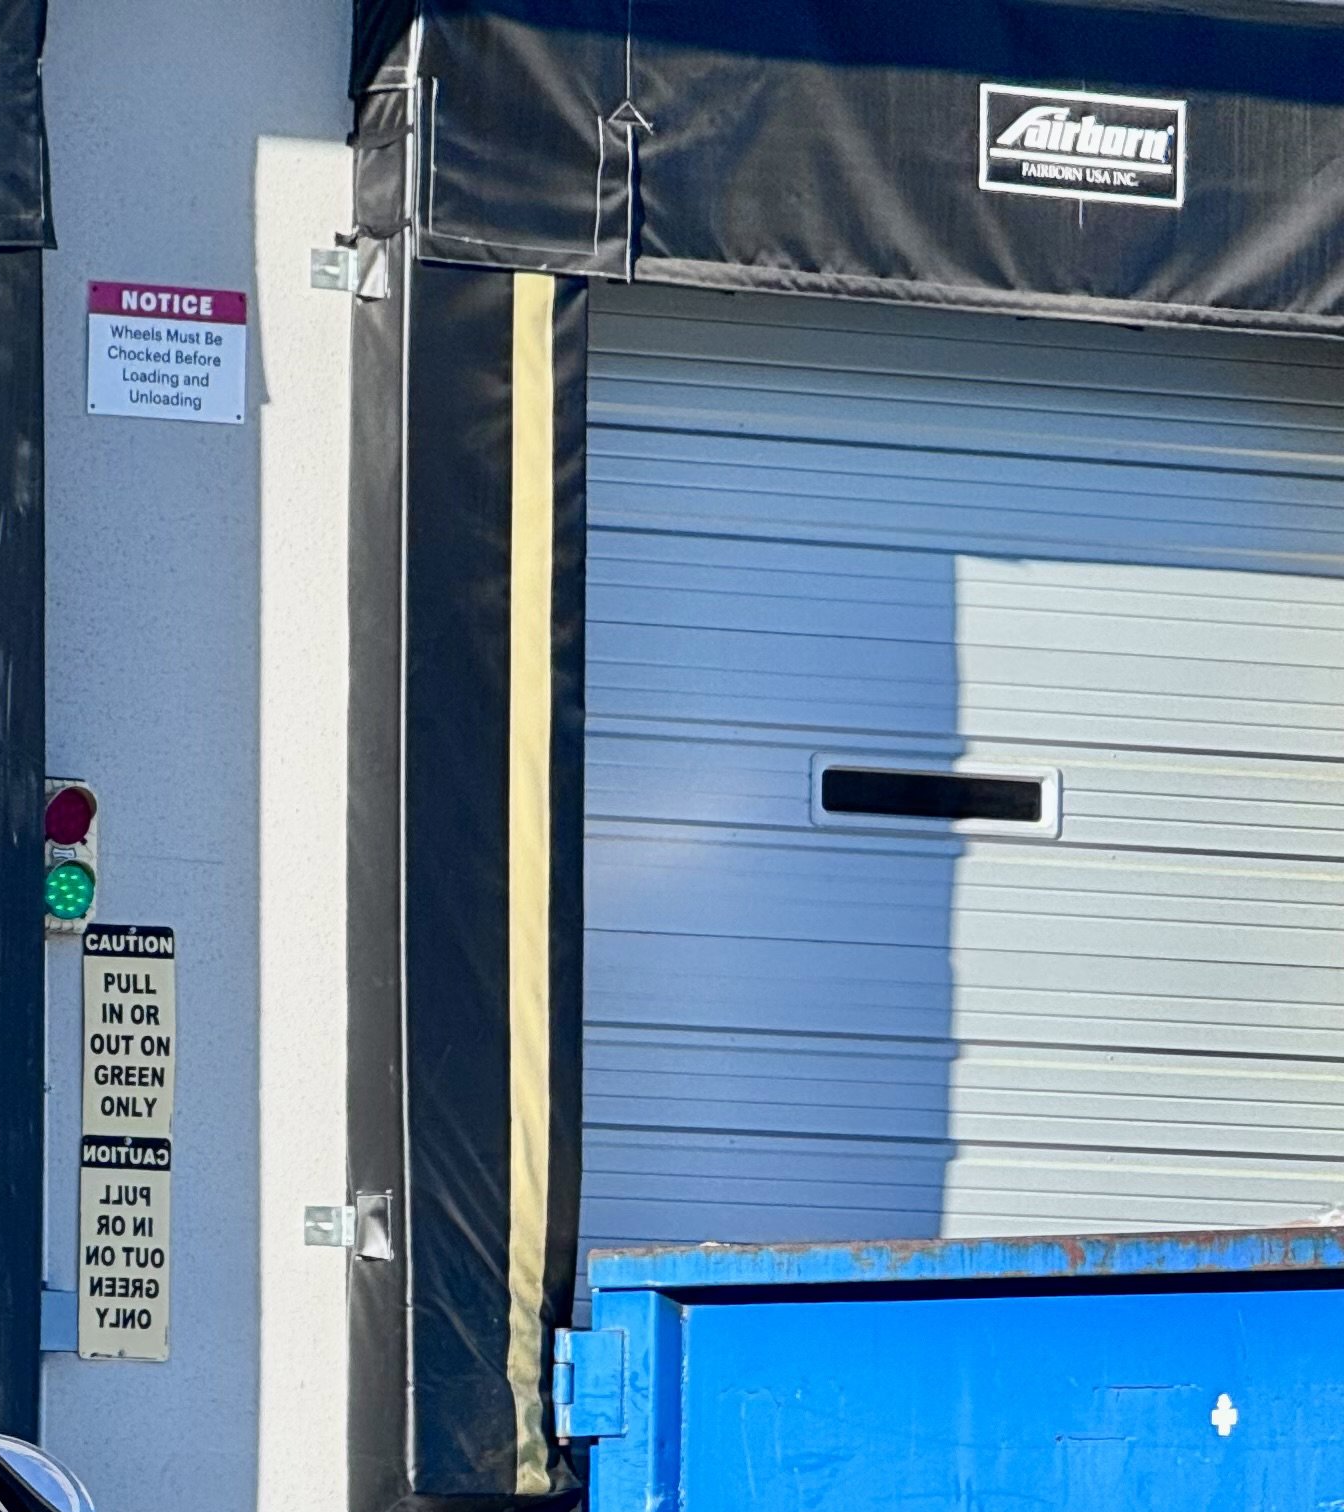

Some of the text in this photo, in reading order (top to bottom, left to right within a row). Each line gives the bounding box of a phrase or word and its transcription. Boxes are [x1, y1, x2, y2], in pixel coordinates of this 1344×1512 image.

[996, 106, 1171, 162] Fairborn
[1021, 161, 1083, 182] FAIRBORN
[1086, 167, 1111, 185] USA
[121, 290, 213, 316] NOTICE
[110, 324, 224, 347] Wheels Must Be
[107, 345, 222, 367] Chocked Before
[122, 368, 210, 389] Loading and
[129, 389, 202, 411] Unloading
[85, 934, 174, 956] CAUTION
[103, 972, 158, 995] PULL
[102, 1003, 160, 1026] IN OR
[90, 1033, 171, 1057] OUT ON
[94, 1064, 165, 1088] GREEN
[100, 1095, 158, 1118] ONLY
